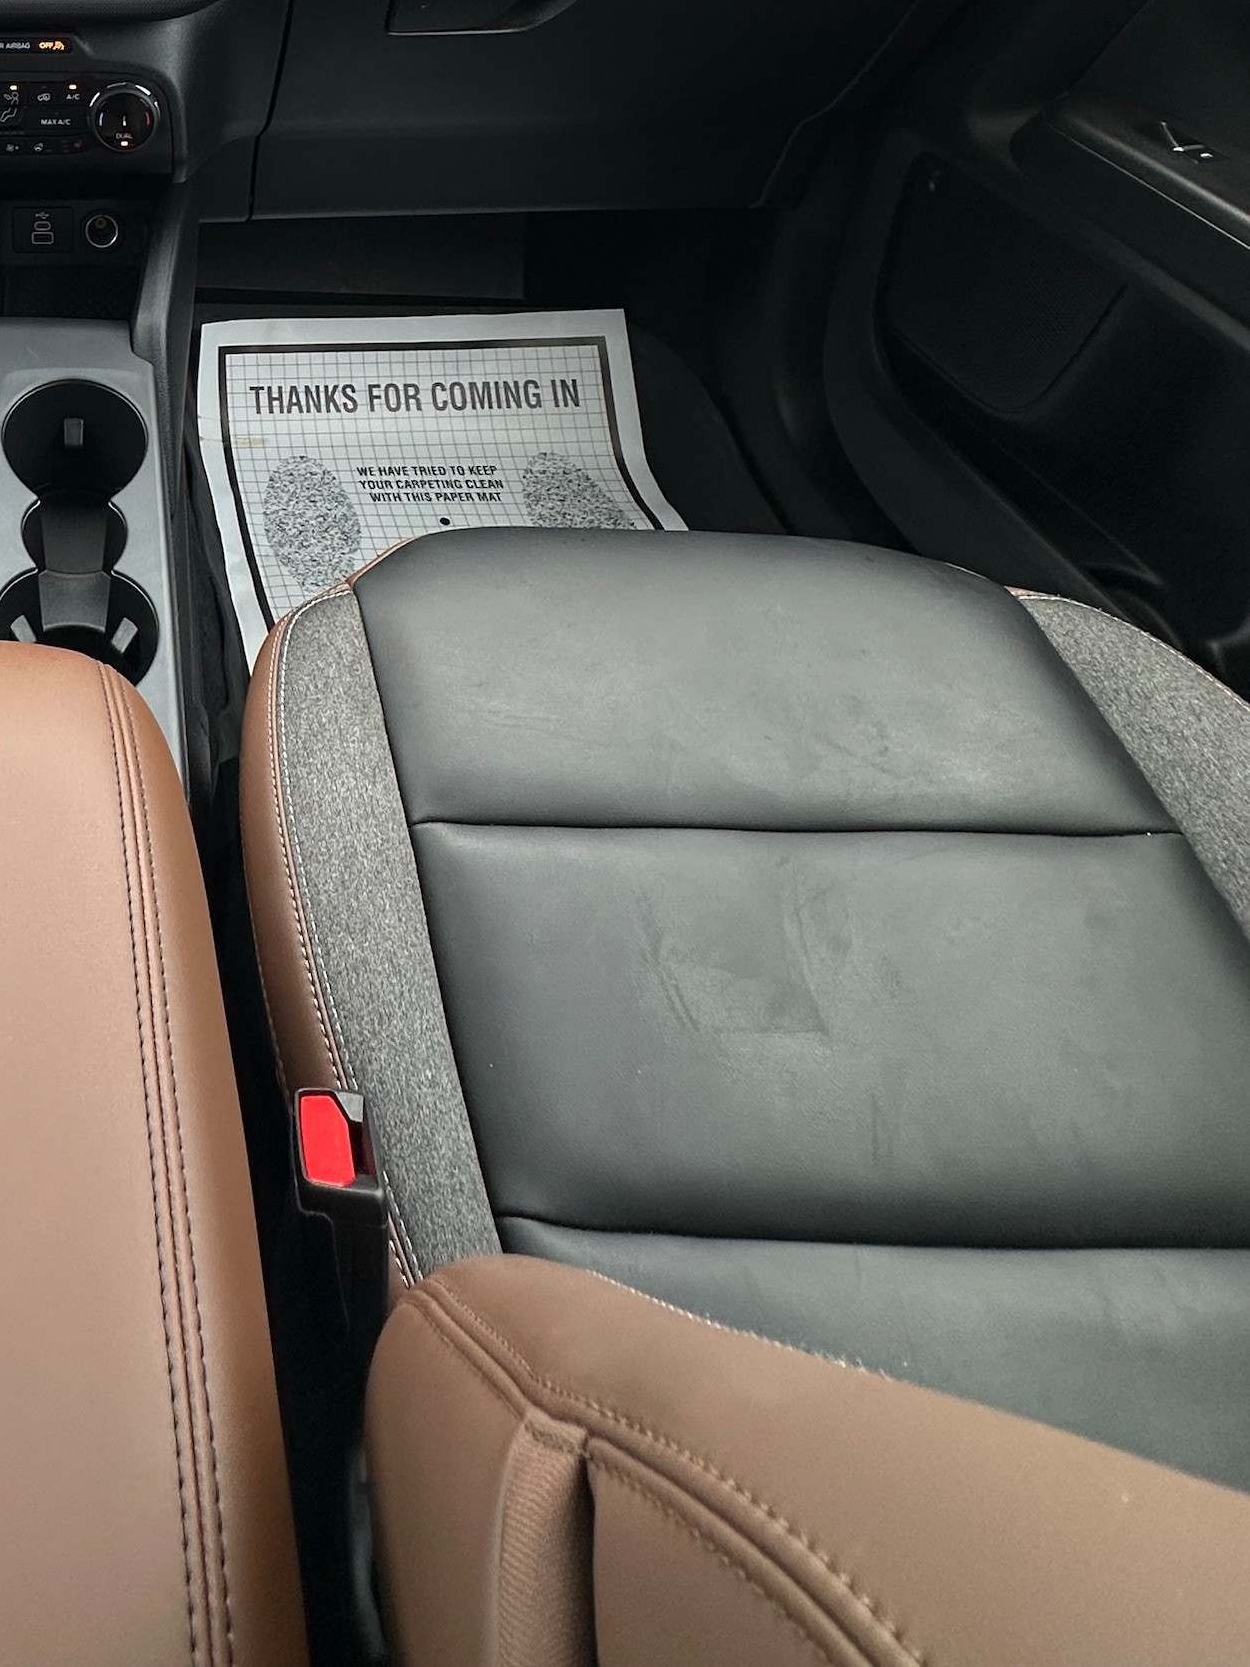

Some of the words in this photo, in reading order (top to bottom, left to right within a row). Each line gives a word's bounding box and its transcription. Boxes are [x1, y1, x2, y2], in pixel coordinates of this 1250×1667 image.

[5, 42, 30, 50] AIRBAG
[39, 42, 53, 50] OFF
[66, 93, 80, 101] A/C
[250, 384, 358, 415] THANKS
[368, 382, 422, 413] FOR
[430, 380, 542, 412] COMING
[550, 379, 580, 408] IN
[356, 466, 377, 477] WE
[378, 466, 408, 477] HAVE
[411, 466, 447, 476] TRIED
[449, 465, 466, 476] TO
[468, 465, 497, 475] KEEP
[358, 480, 393, 490] YOUR
[395, 479, 463, 490] CARPETING
[465, 479, 504, 489] CLEAN
[369, 492, 402, 503] WITH
[405, 492, 432, 503] THIS
[436, 492, 474, 503] PAPER
[477, 492, 502, 502] MAT
